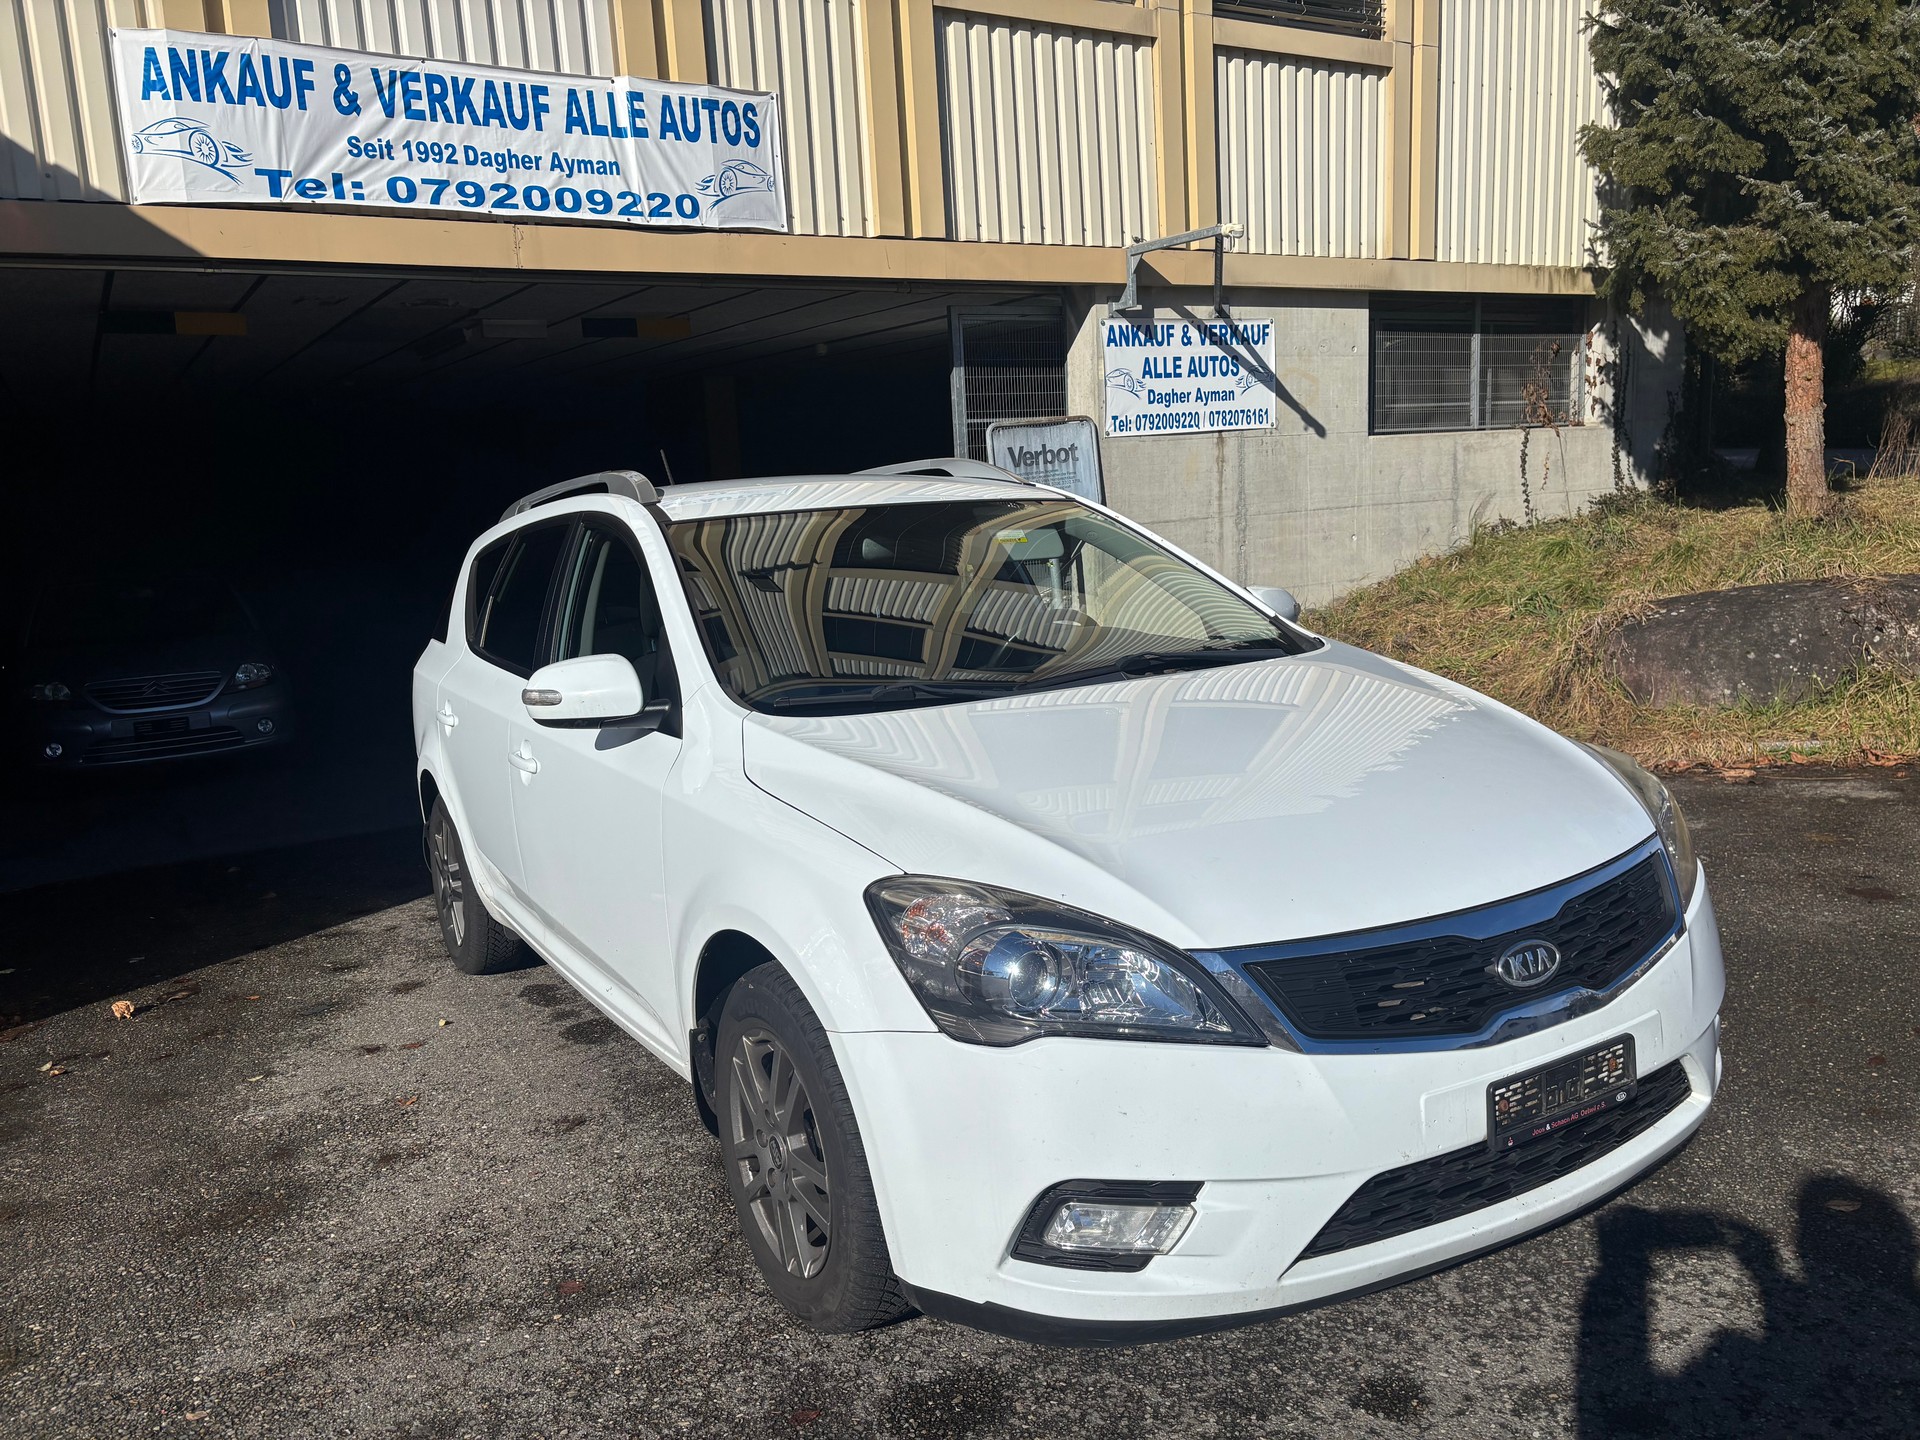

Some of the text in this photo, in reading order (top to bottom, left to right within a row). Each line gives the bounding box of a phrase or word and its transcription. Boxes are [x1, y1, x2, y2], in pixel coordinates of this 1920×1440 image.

[141, 46, 761, 149] ANKAUF & VERKAUF ALLE AUTOS
[347, 135, 621, 178] Seit 1992 Dagher Ayman
[255, 168, 700, 219] Tel: 0792009220
[1106, 323, 1270, 347] ANKAUF & VERKAUF
[1141, 355, 1240, 379] ALLE AUTOS
[1147, 387, 1235, 408] Dagher Ayman
[1111, 415, 1132, 432] Tel:
[1135, 411, 1200, 431] 0792009220
[1209, 408, 1269, 427] 0782076161
[1007, 443, 1080, 468] Verbot
[1507, 947, 1553, 980] KIA
[1546, 1123, 1551, 1131] &
[1570, 1112, 1579, 1121] AG
